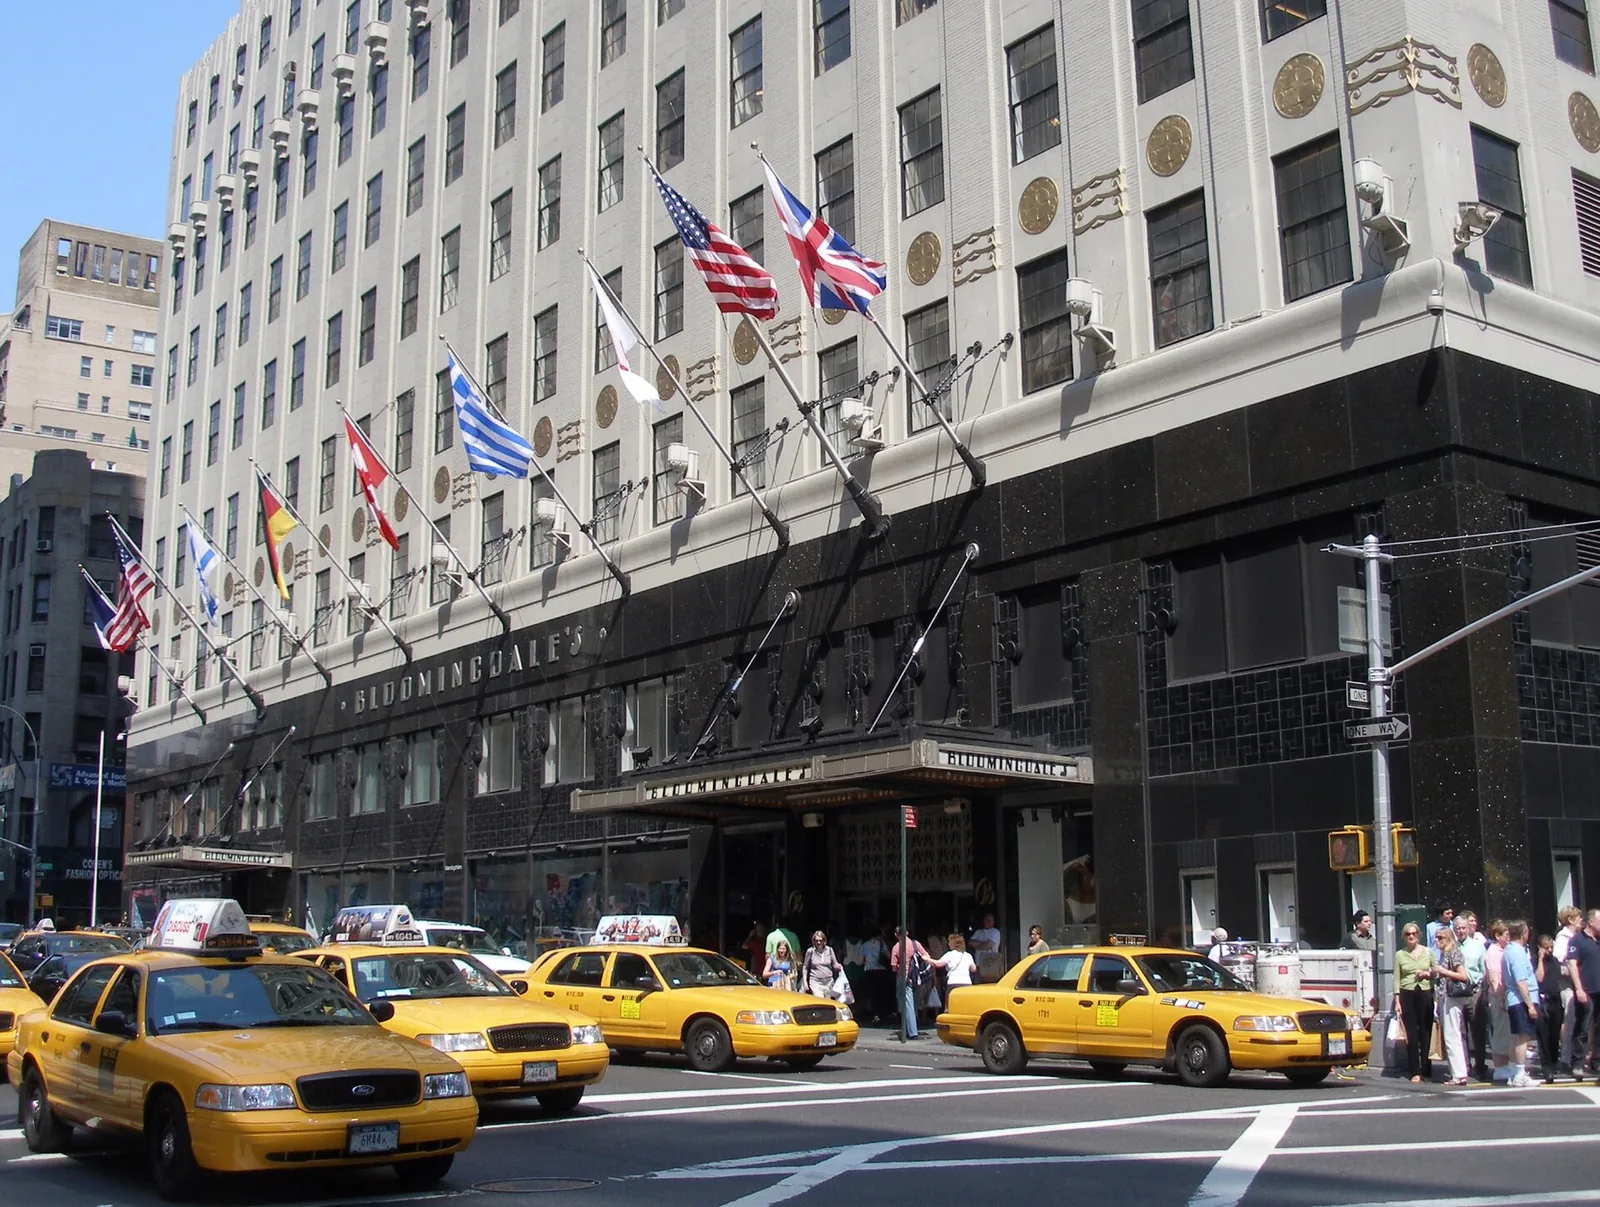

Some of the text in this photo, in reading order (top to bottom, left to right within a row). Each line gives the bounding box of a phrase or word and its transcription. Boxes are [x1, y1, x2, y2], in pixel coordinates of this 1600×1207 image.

[354, 624, 584, 715] BLOOMINGDALE'S
[1353, 689, 1367, 701] ONE
[1348, 722, 1399, 738] ONE WAY
[75, 770, 109, 780] Advand
[82, 859, 113, 870] COEN'S
[166, 920, 192, 933] DISCUSS
[395, 931, 412, 941] 6G43
